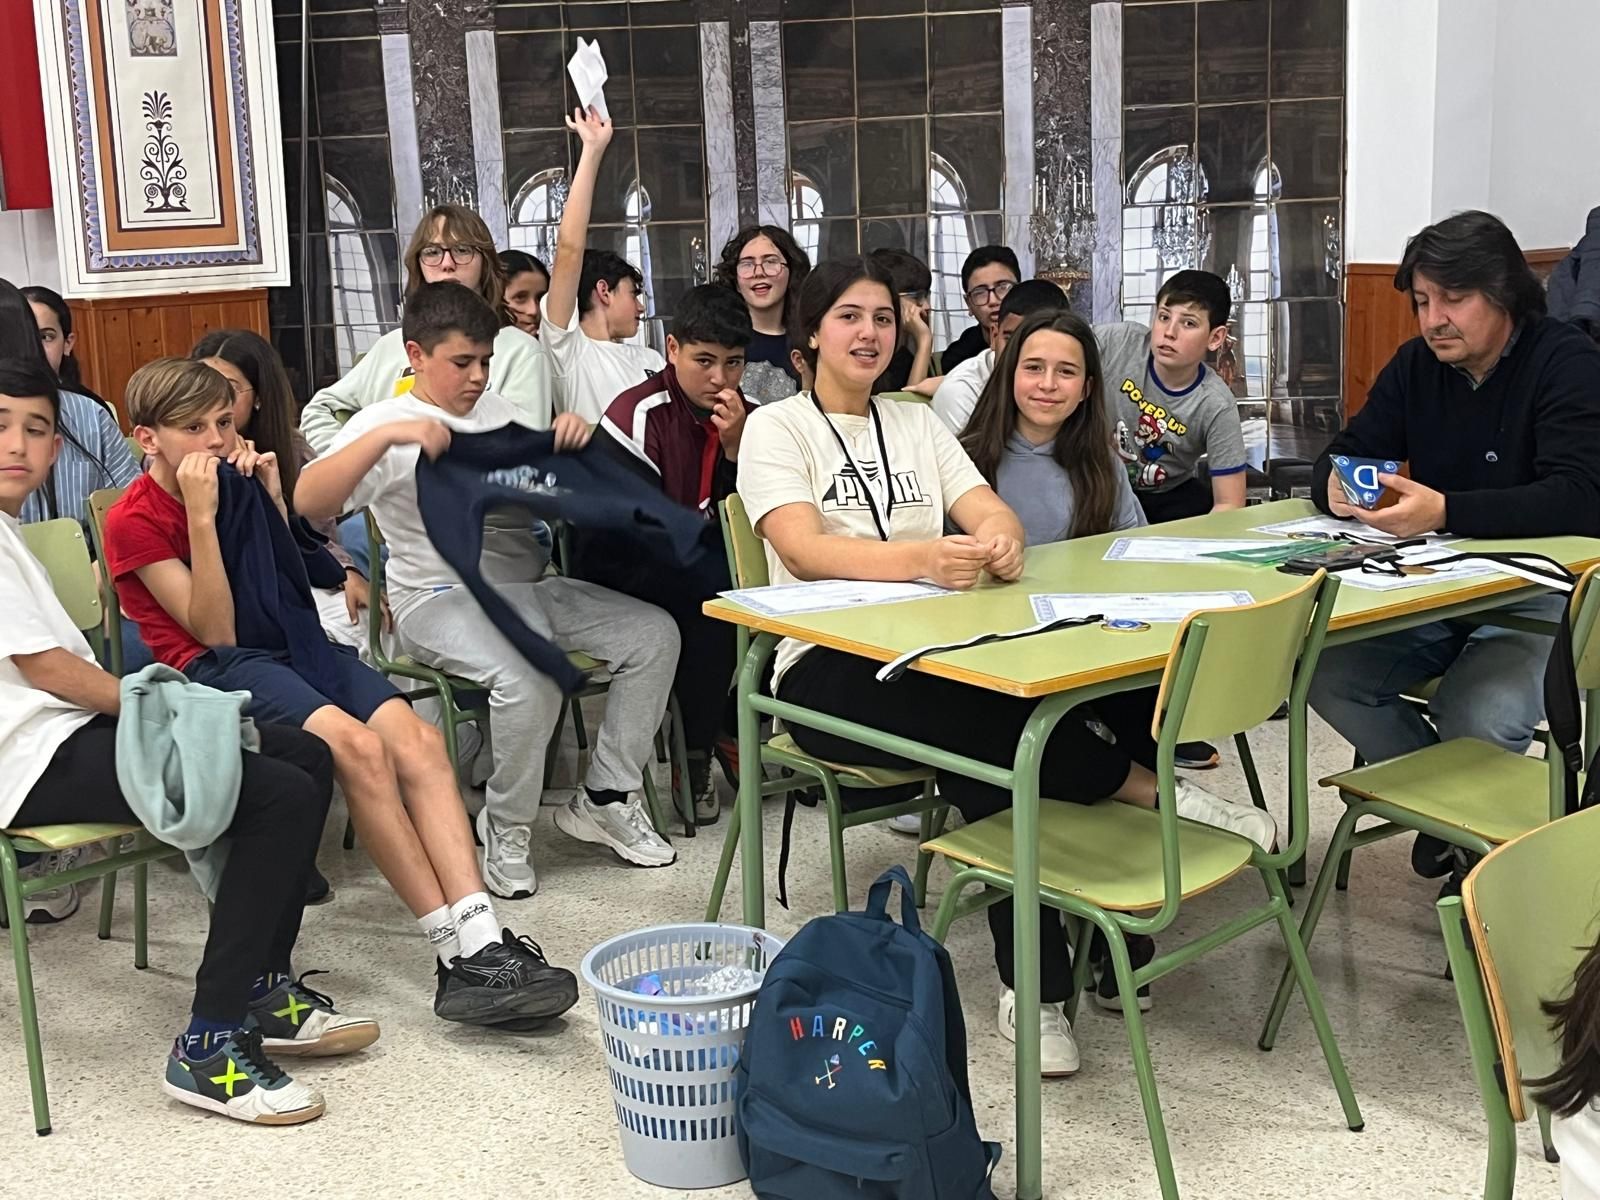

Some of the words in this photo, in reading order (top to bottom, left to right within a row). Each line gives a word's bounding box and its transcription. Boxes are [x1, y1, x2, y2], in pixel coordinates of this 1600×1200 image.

[1120, 378, 1167, 421] POWER
[1167, 416, 1187, 436] UP
[790, 1015, 887, 1071] HARPER
